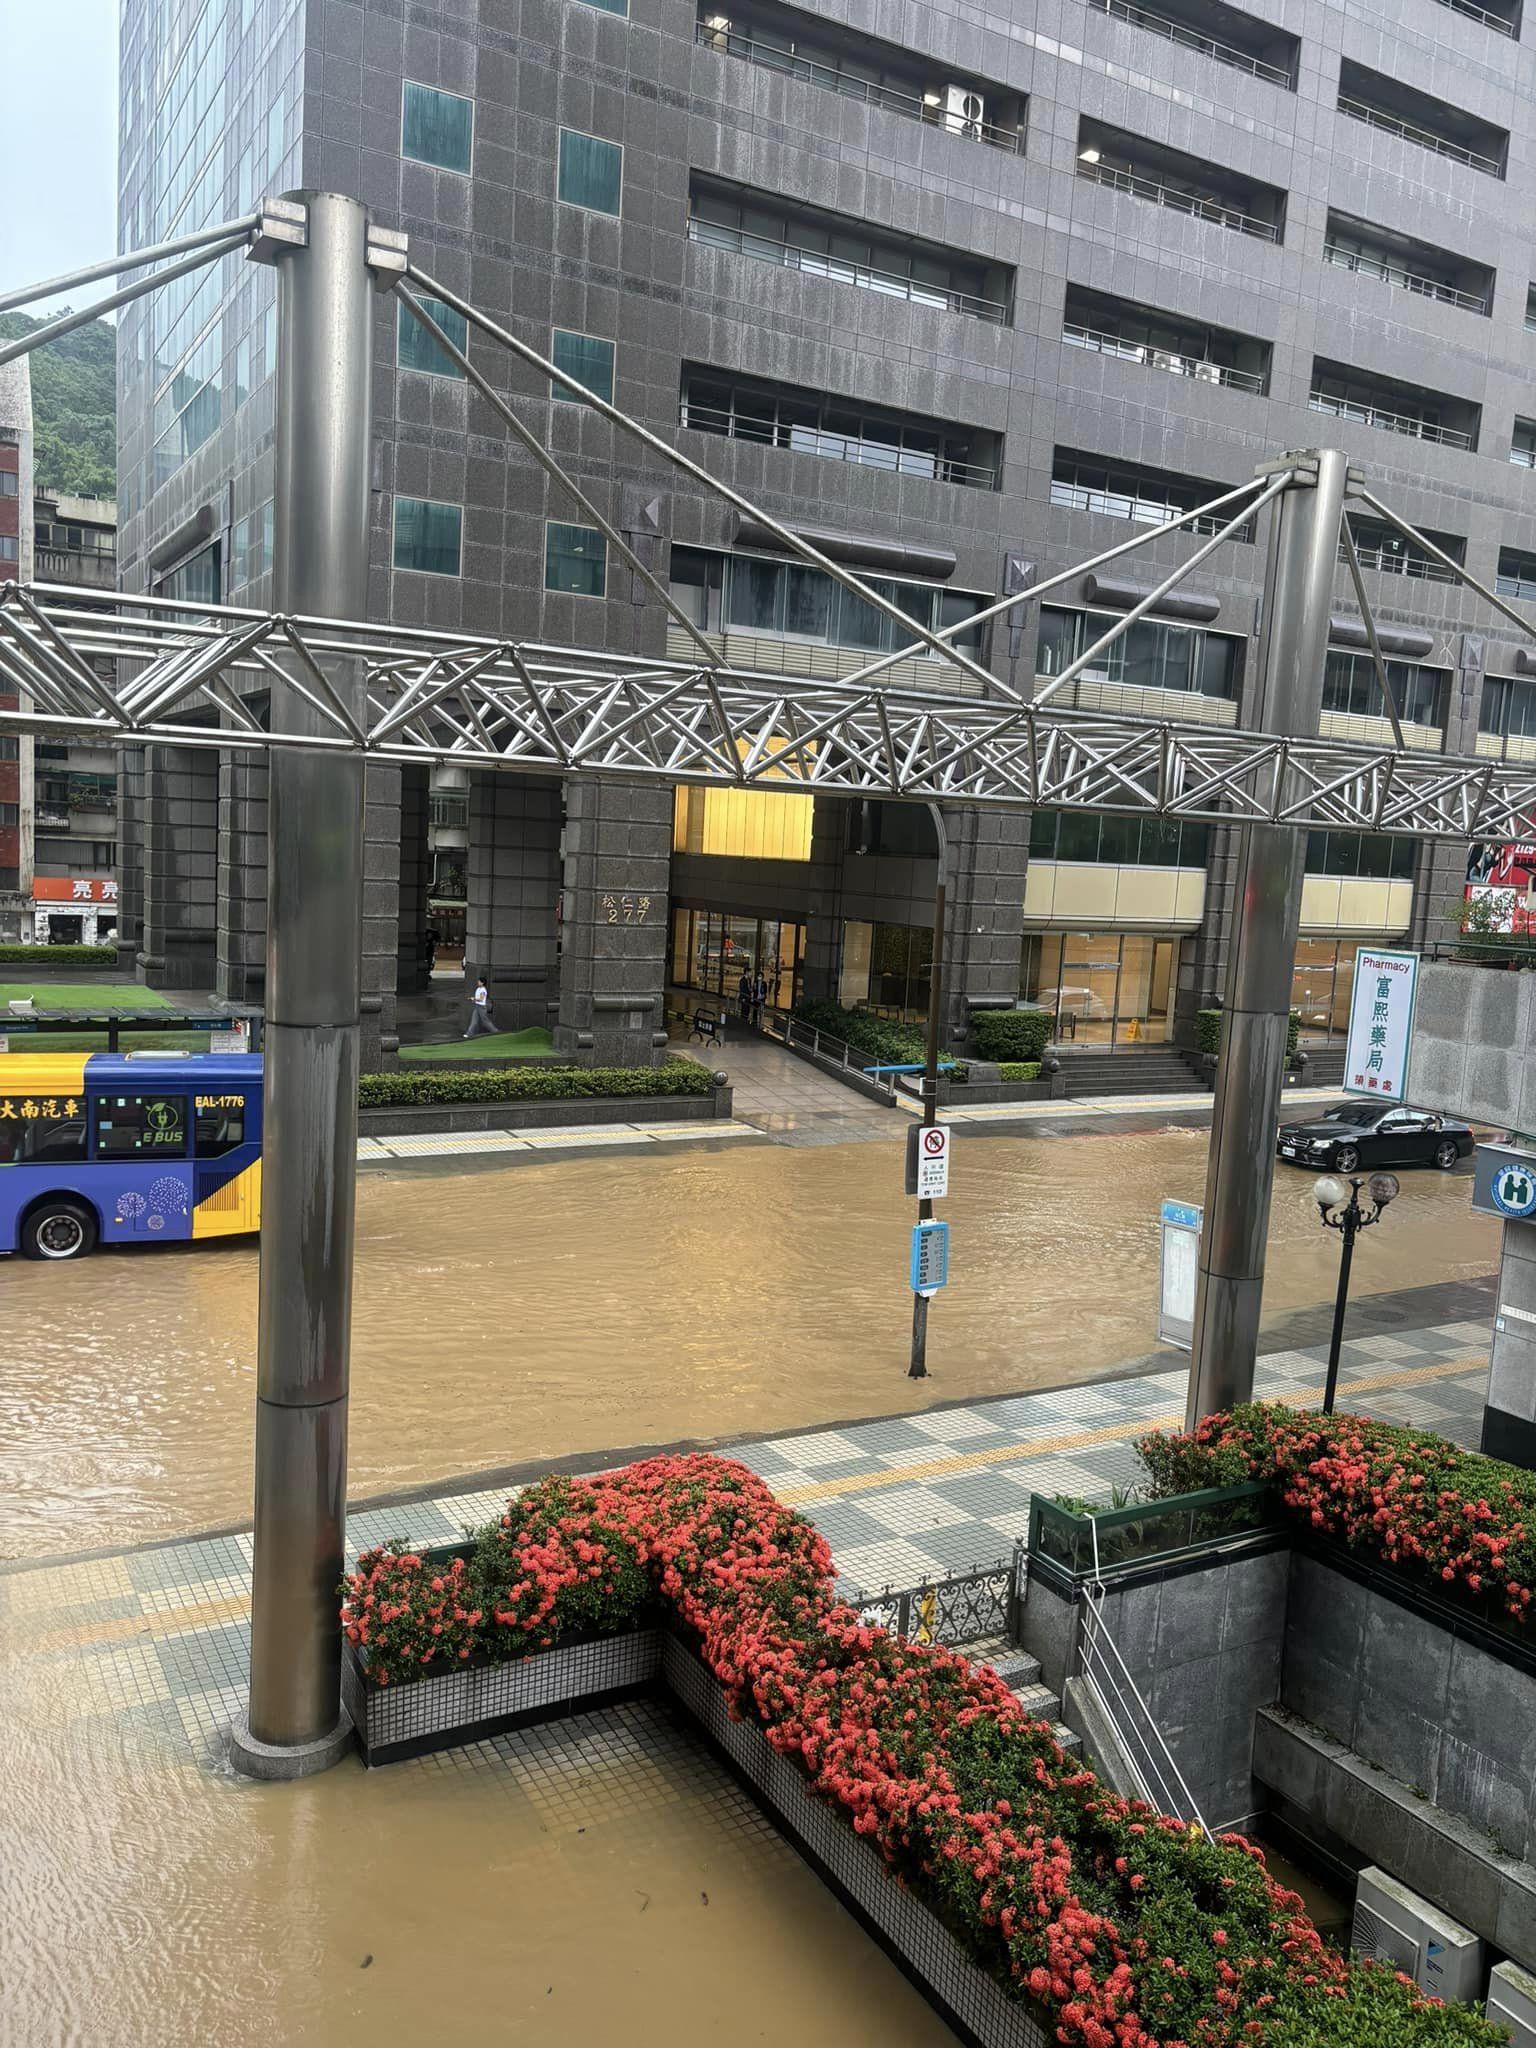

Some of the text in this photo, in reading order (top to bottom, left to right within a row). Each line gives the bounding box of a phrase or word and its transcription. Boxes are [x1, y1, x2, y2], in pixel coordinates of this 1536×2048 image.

[608, 909, 647, 923] 277
[1362, 957, 1410, 974] Pharmacy
[1366, 975, 1392, 1073] 富熙藥局
[195, 1095, 245, 1108] EAL-1776
[0, 1099, 79, 1120] 大南汽車
[143, 1131, 183, 1142] E BUS
